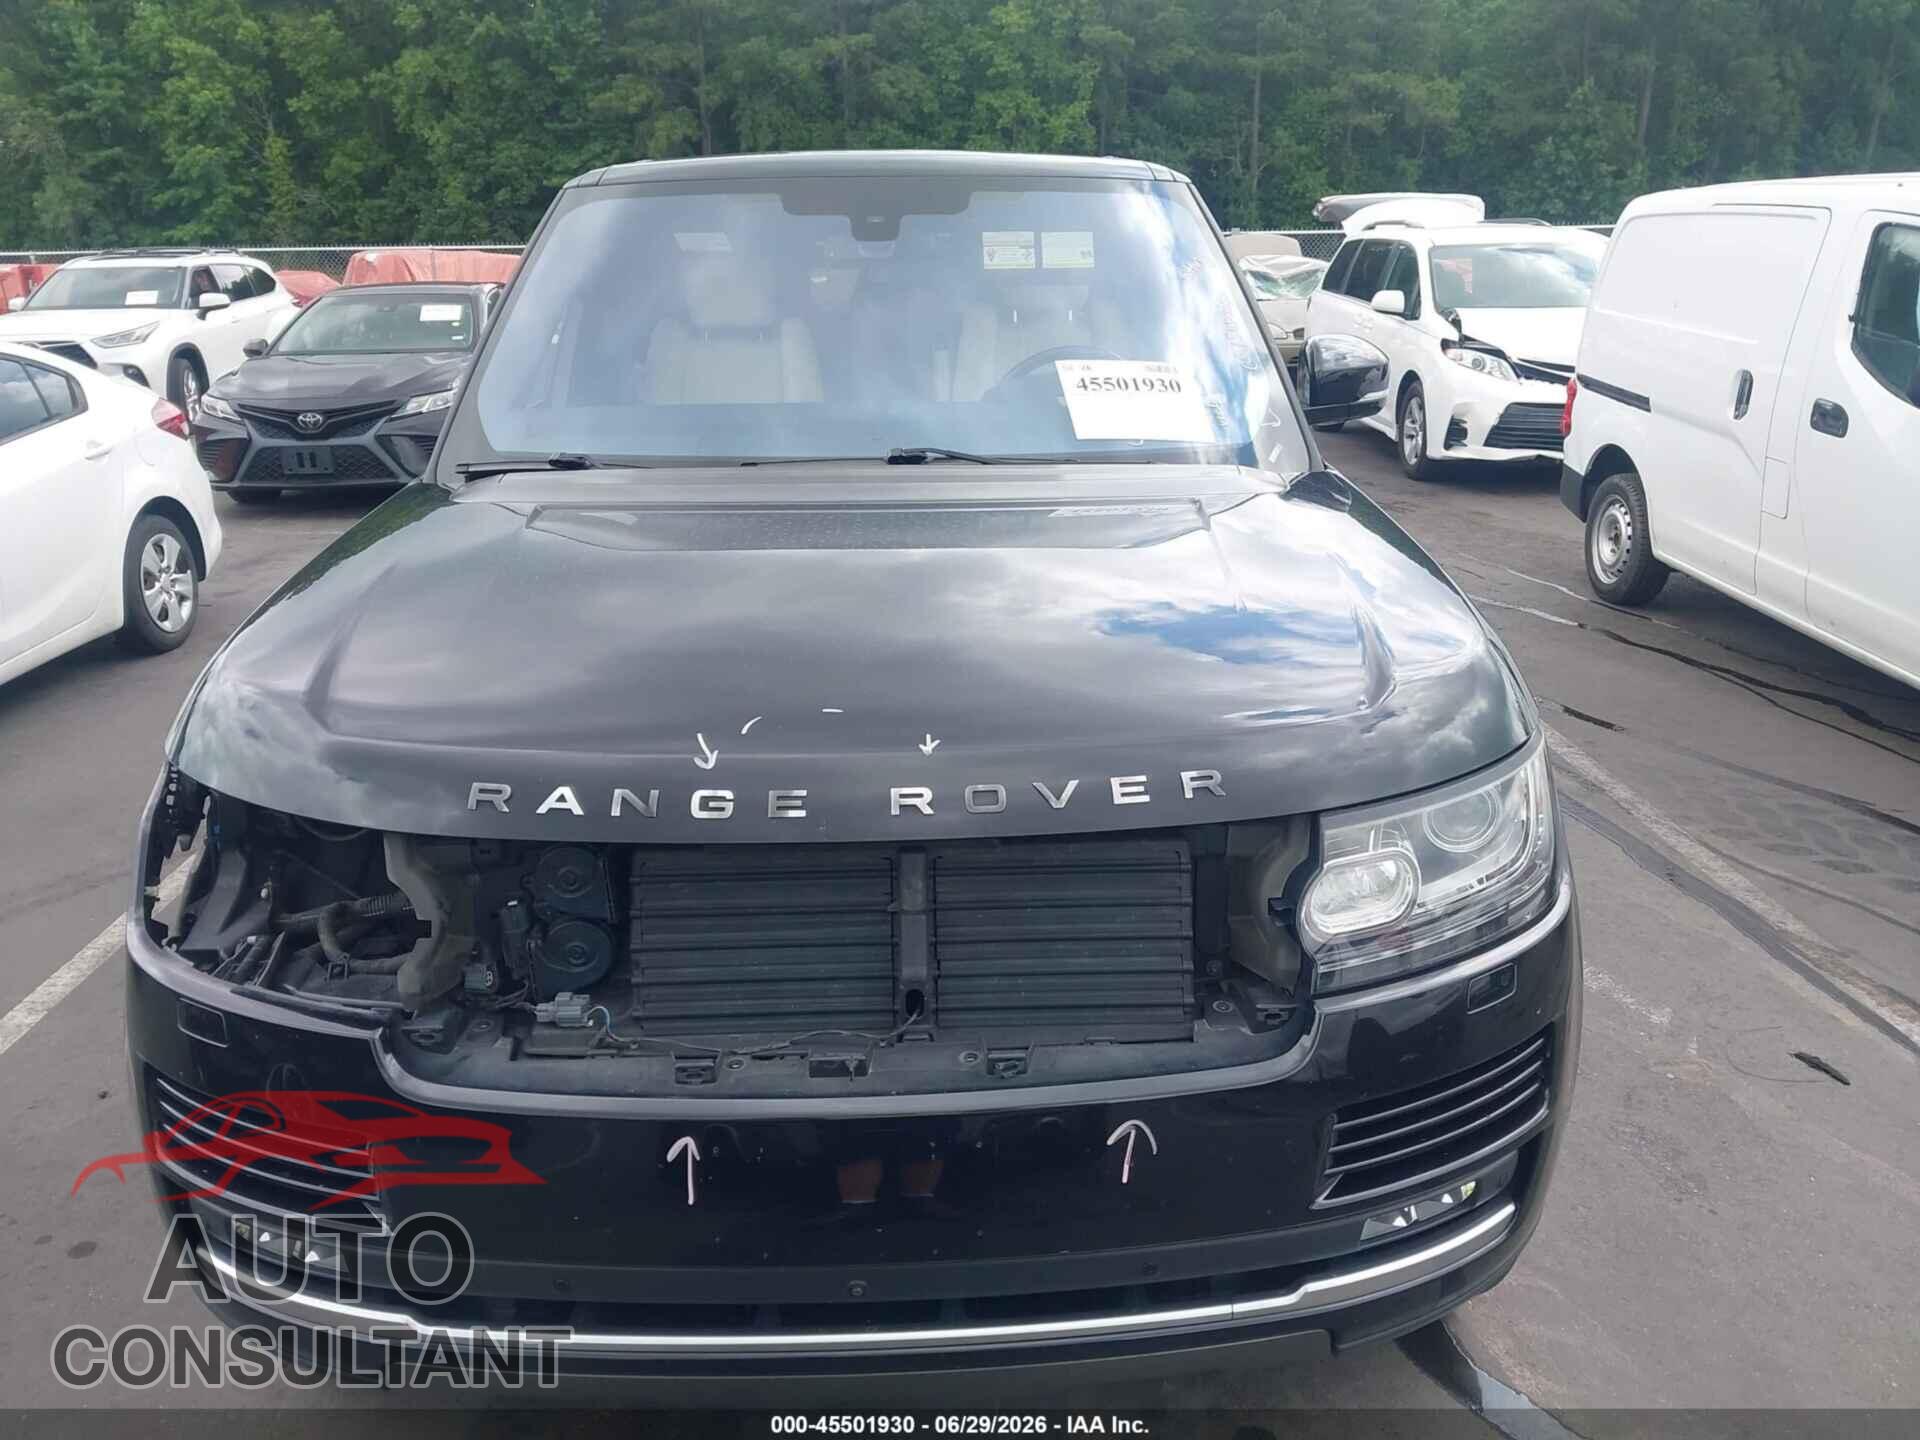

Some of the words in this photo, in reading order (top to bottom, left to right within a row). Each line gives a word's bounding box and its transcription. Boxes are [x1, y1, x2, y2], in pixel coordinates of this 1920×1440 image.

[1076, 377, 1182, 393] 45501930
[467, 781, 808, 819] RANGE
[890, 769, 1226, 816] ROVER
